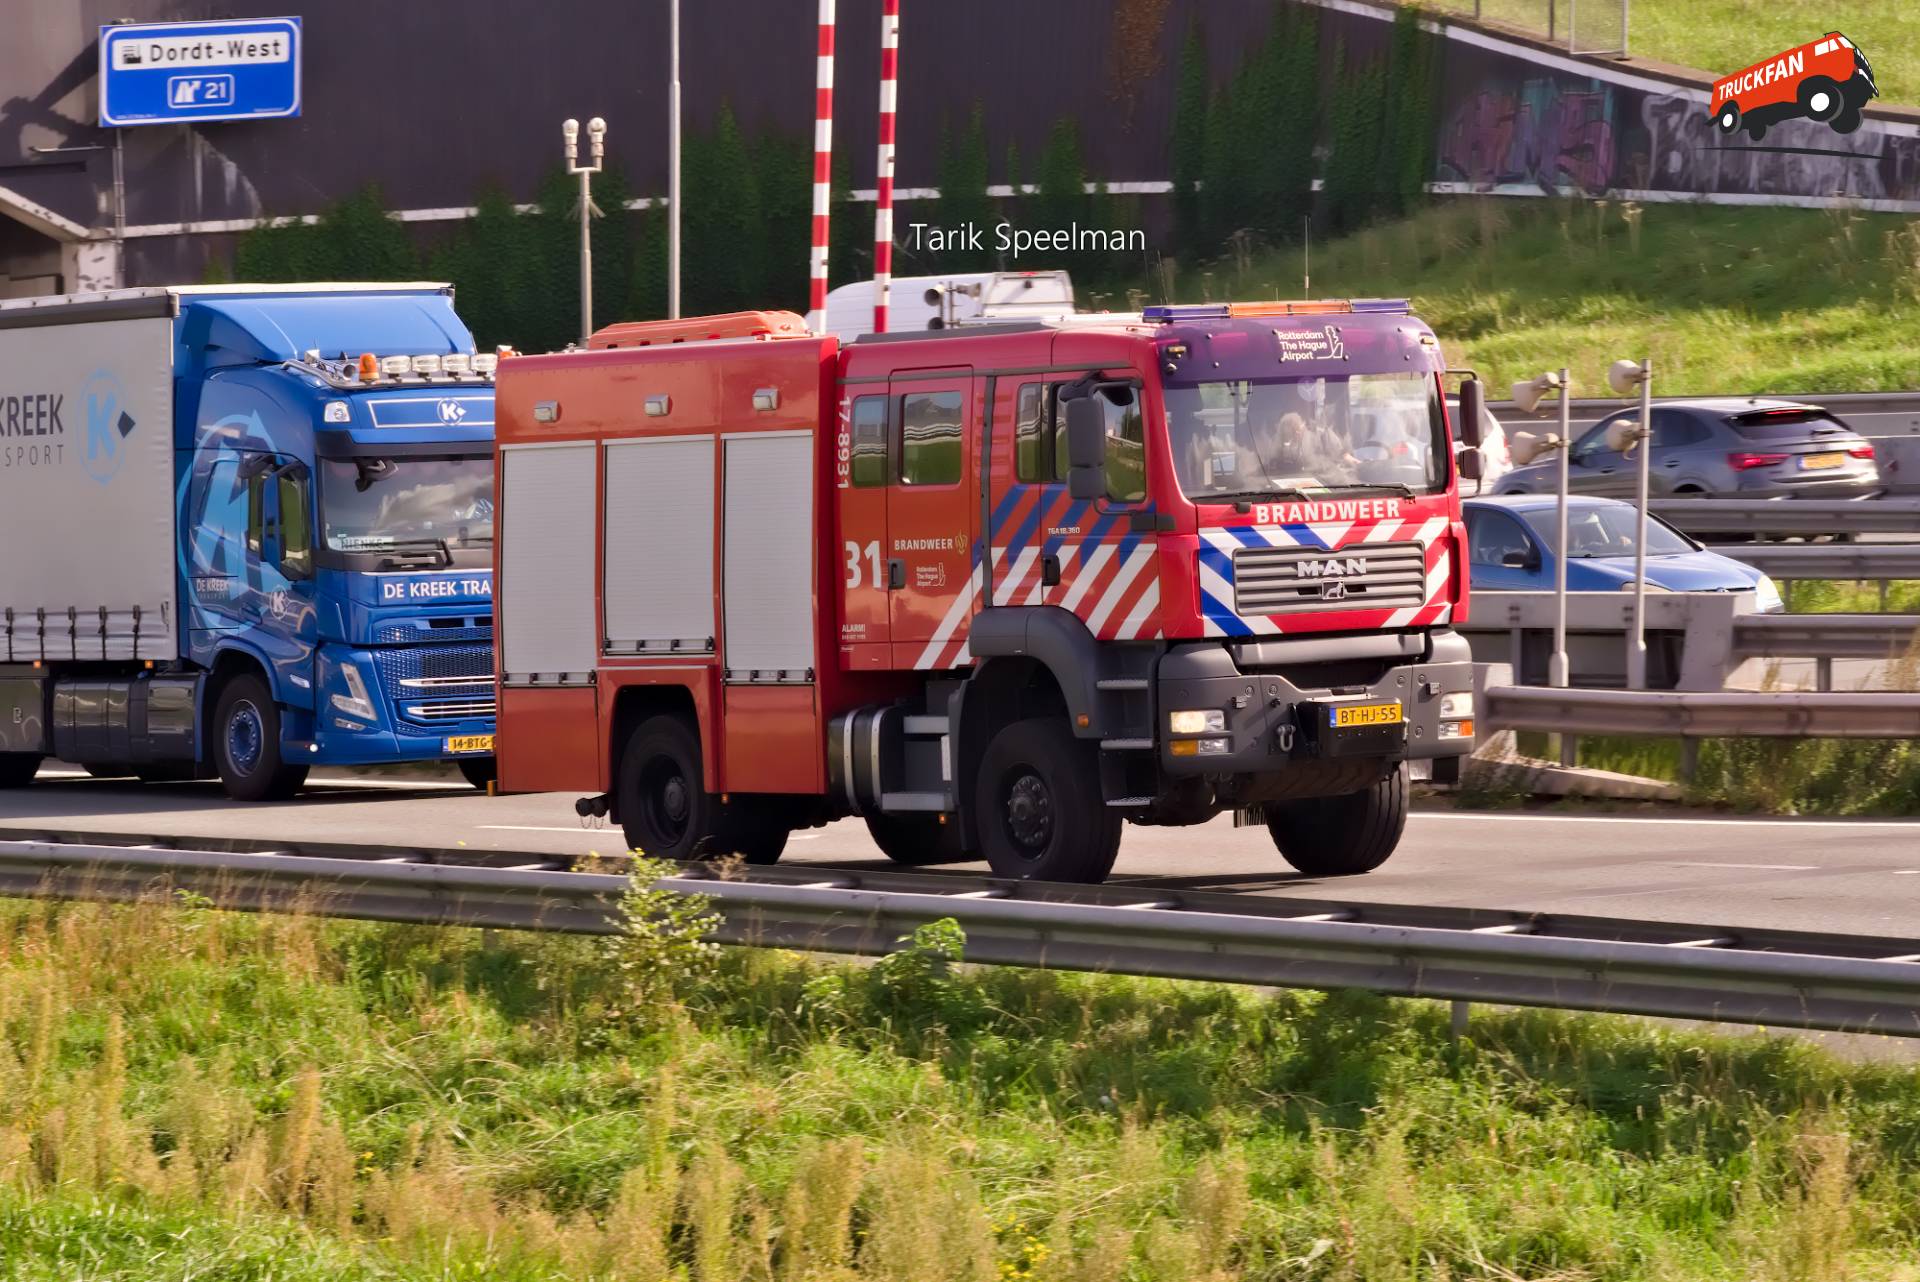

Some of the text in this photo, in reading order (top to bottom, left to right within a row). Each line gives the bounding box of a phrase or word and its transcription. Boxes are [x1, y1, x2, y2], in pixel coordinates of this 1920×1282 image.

[150, 40, 281, 62] Dordt-West
[204, 82, 227, 99] 21
[1277, 330, 1324, 341] Rotterdam
[1280, 340, 1327, 352] The Hague
[1282, 351, 1313, 362] Airport
[837, 396, 851, 489] 17-8931
[1256, 500, 1400, 524] BRANDWEER
[894, 538, 953, 551] BRANDWEER
[845, 540, 882, 589] 31
[1297, 558, 1367, 577] MAN
[196, 578, 206, 593] DE
[384, 583, 405, 599] DE
[410, 581, 457, 598] KREEK
[1341, 707, 1397, 724] BT-HJ-55
